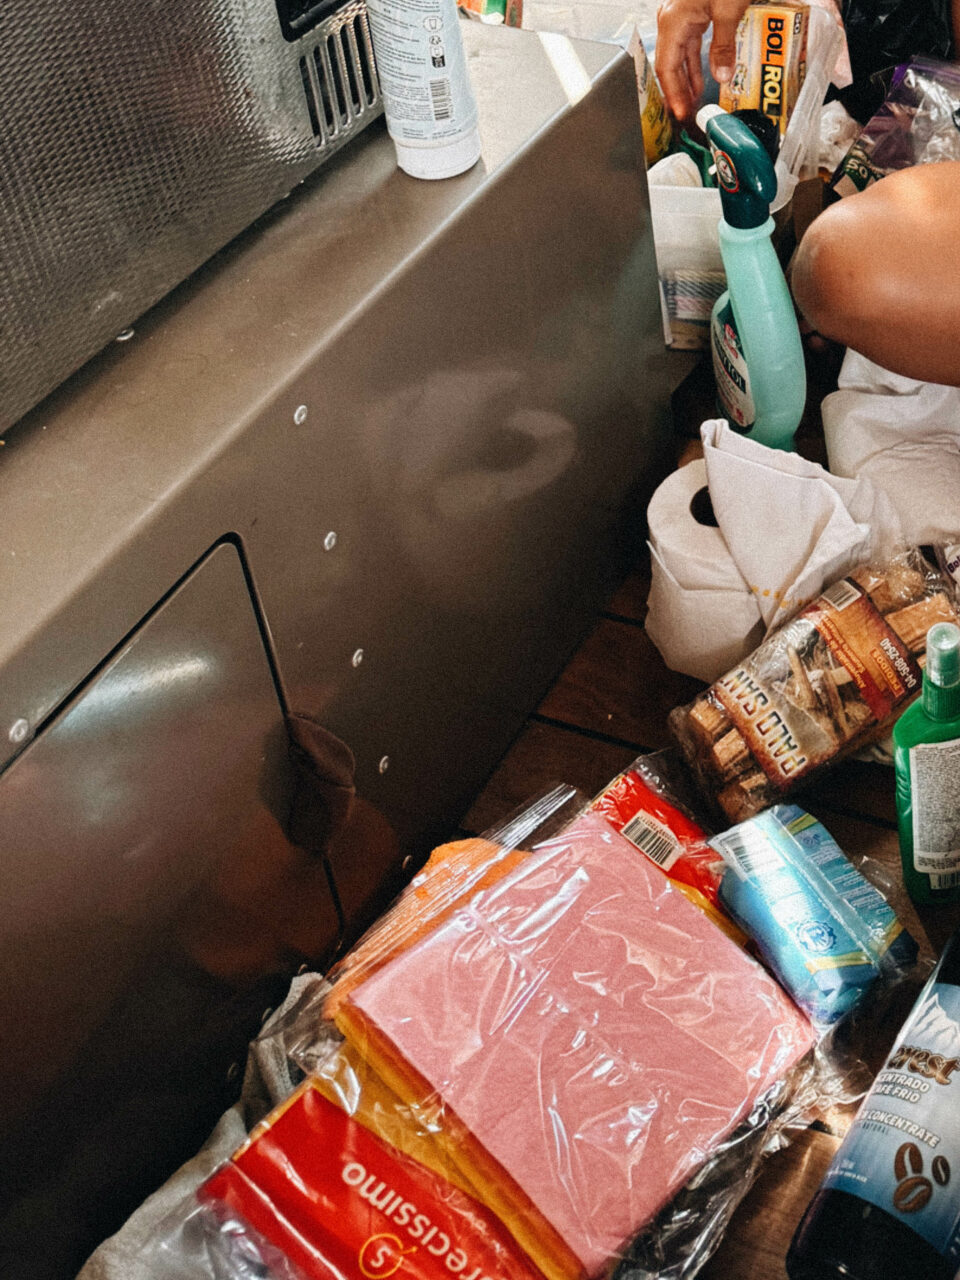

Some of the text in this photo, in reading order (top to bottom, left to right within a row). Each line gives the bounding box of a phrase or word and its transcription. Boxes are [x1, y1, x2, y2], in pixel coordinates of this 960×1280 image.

[766, 18, 784, 62] BOL
[873, 648, 900, 691] PEDIDOS
[756, 711, 806, 777] PALO
[892, 1086, 921, 1104] FRIO
[868, 1110, 941, 1148] CONCENTRATE
[341, 1162, 492, 1280] recissimo
